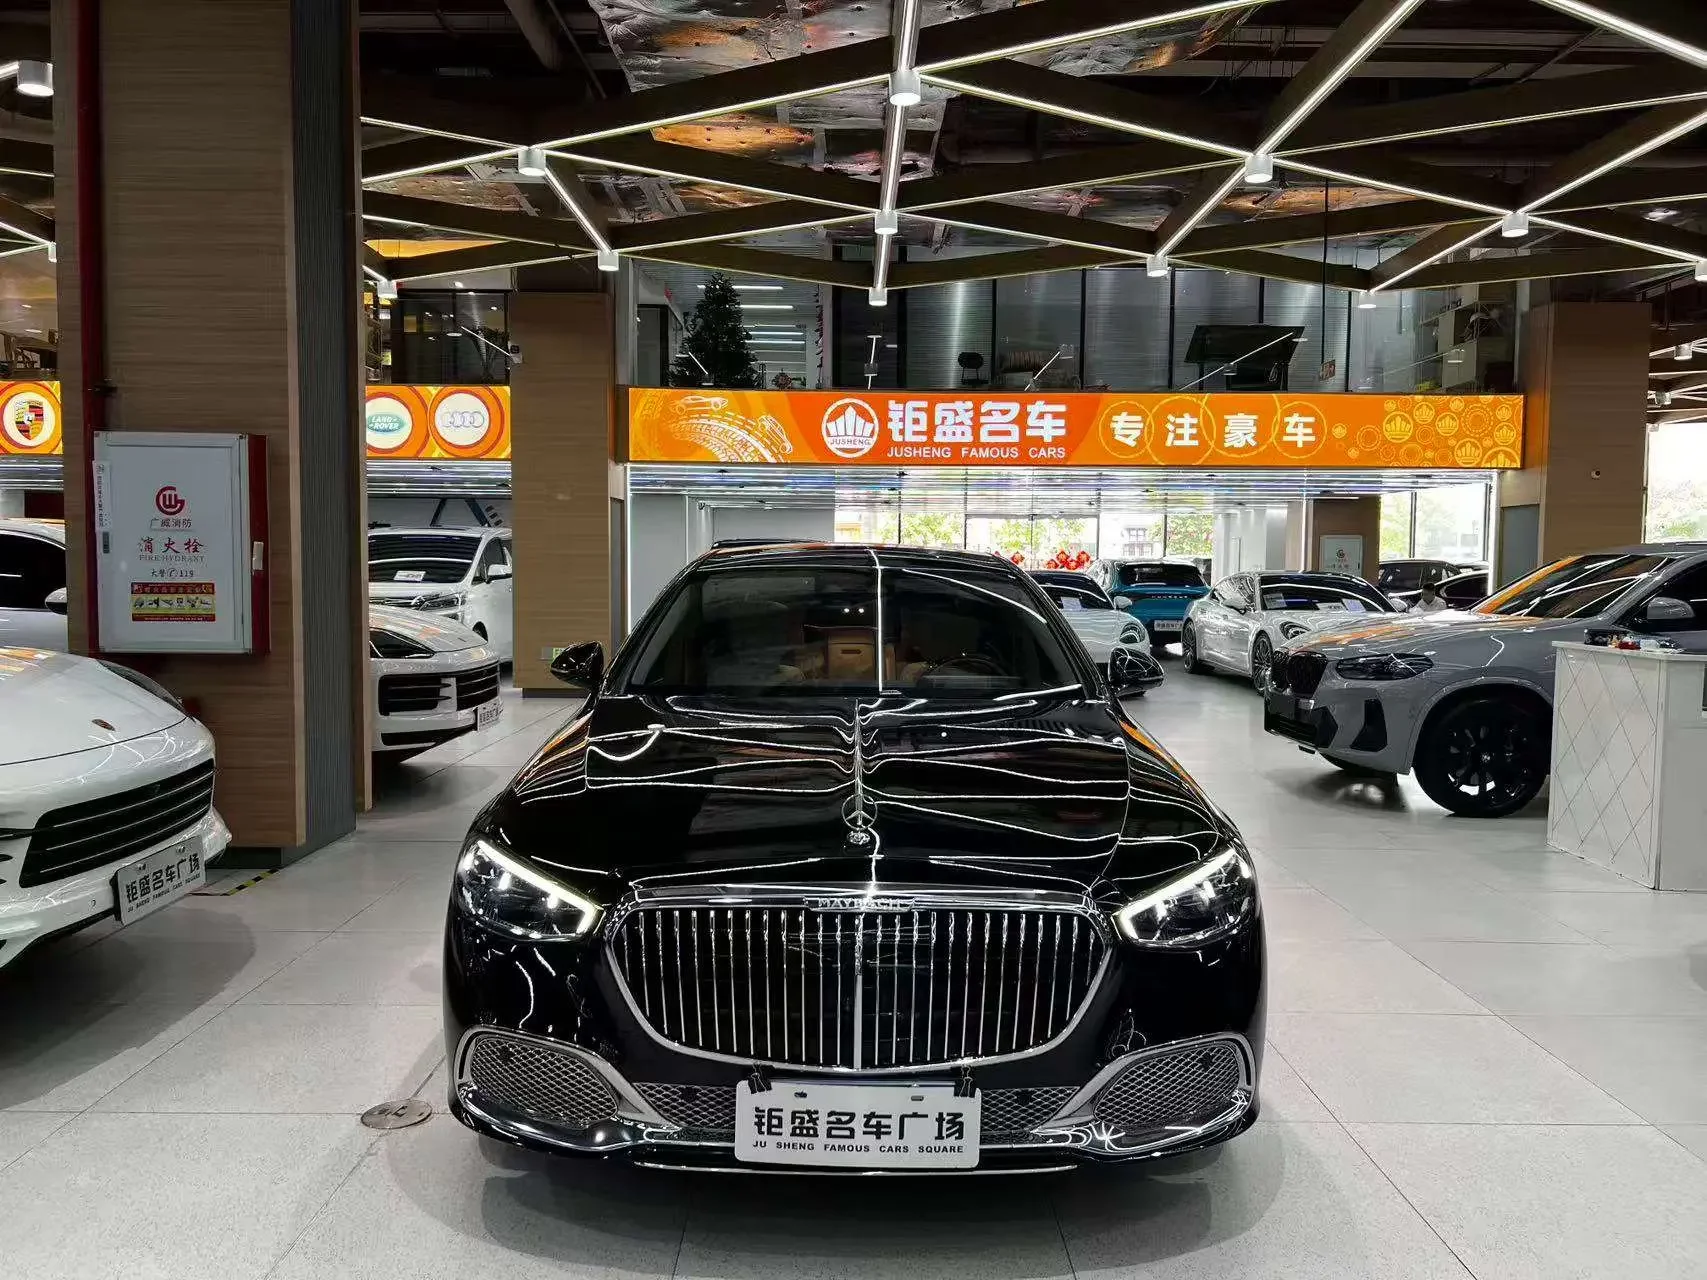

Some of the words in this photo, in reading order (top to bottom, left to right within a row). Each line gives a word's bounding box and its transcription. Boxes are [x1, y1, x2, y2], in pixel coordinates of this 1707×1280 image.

[887, 400, 1067, 443] 钜盛名车
[1111, 412, 1316, 448] 专注豪车
[830, 438, 872, 446] JUSHENG
[887, 447, 952, 458] JUSHENG
[961, 447, 1019, 459] FAMOUS
[1029, 447, 1066, 459] CARS
[138, 537, 204, 554] 消火栓
[126, 852, 200, 903] 钜盛名车广场
[754, 1106, 964, 1140] 钜盛名车广场
[776, 1142, 815, 1151] SHENG
[824, 1144, 870, 1153] FAMOUS
[879, 1145, 909, 1153] CARS
[918, 1145, 964, 1154] SQUARE
